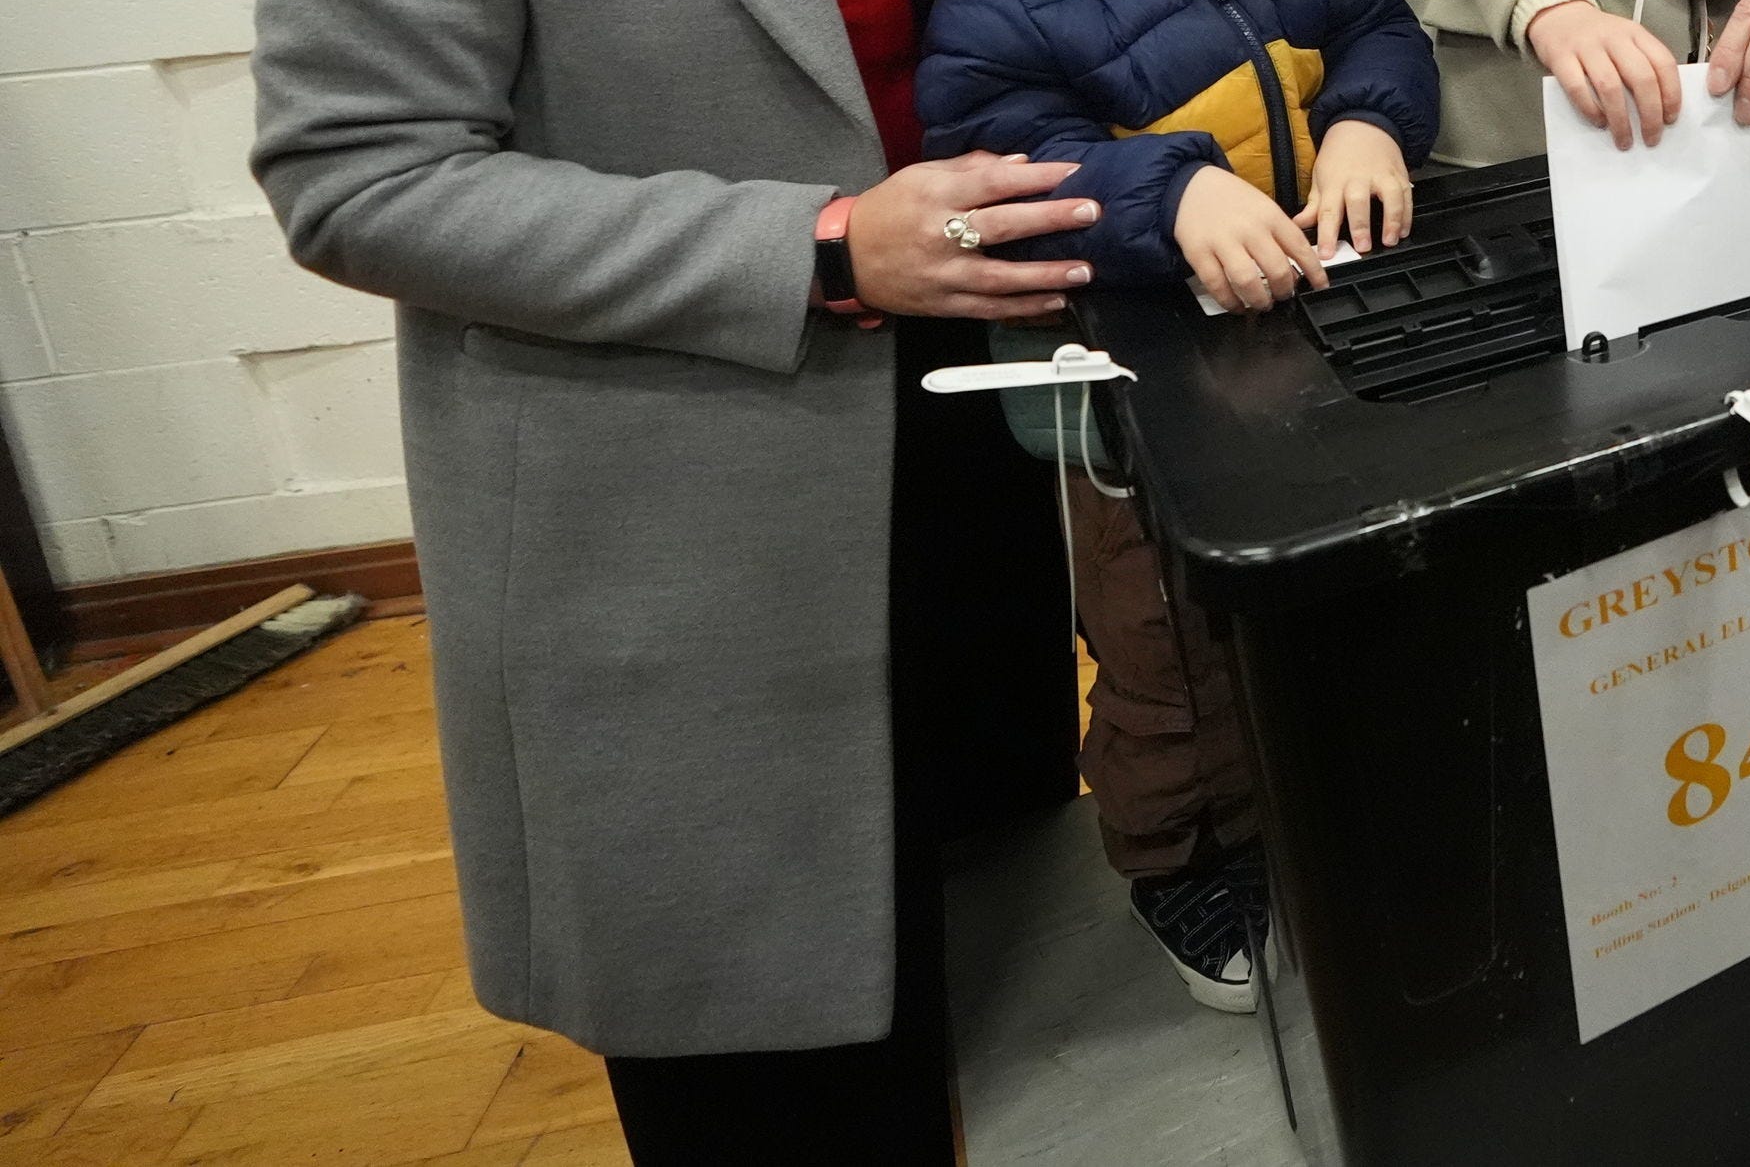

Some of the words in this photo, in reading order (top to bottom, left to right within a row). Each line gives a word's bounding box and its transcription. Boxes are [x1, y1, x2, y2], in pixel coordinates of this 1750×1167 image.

[1588, 630, 1714, 697] GENERAL
[1590, 899, 1633, 926] Booth
[1594, 929, 1645, 960] Polling
[1647, 899, 1701, 930] Station:
